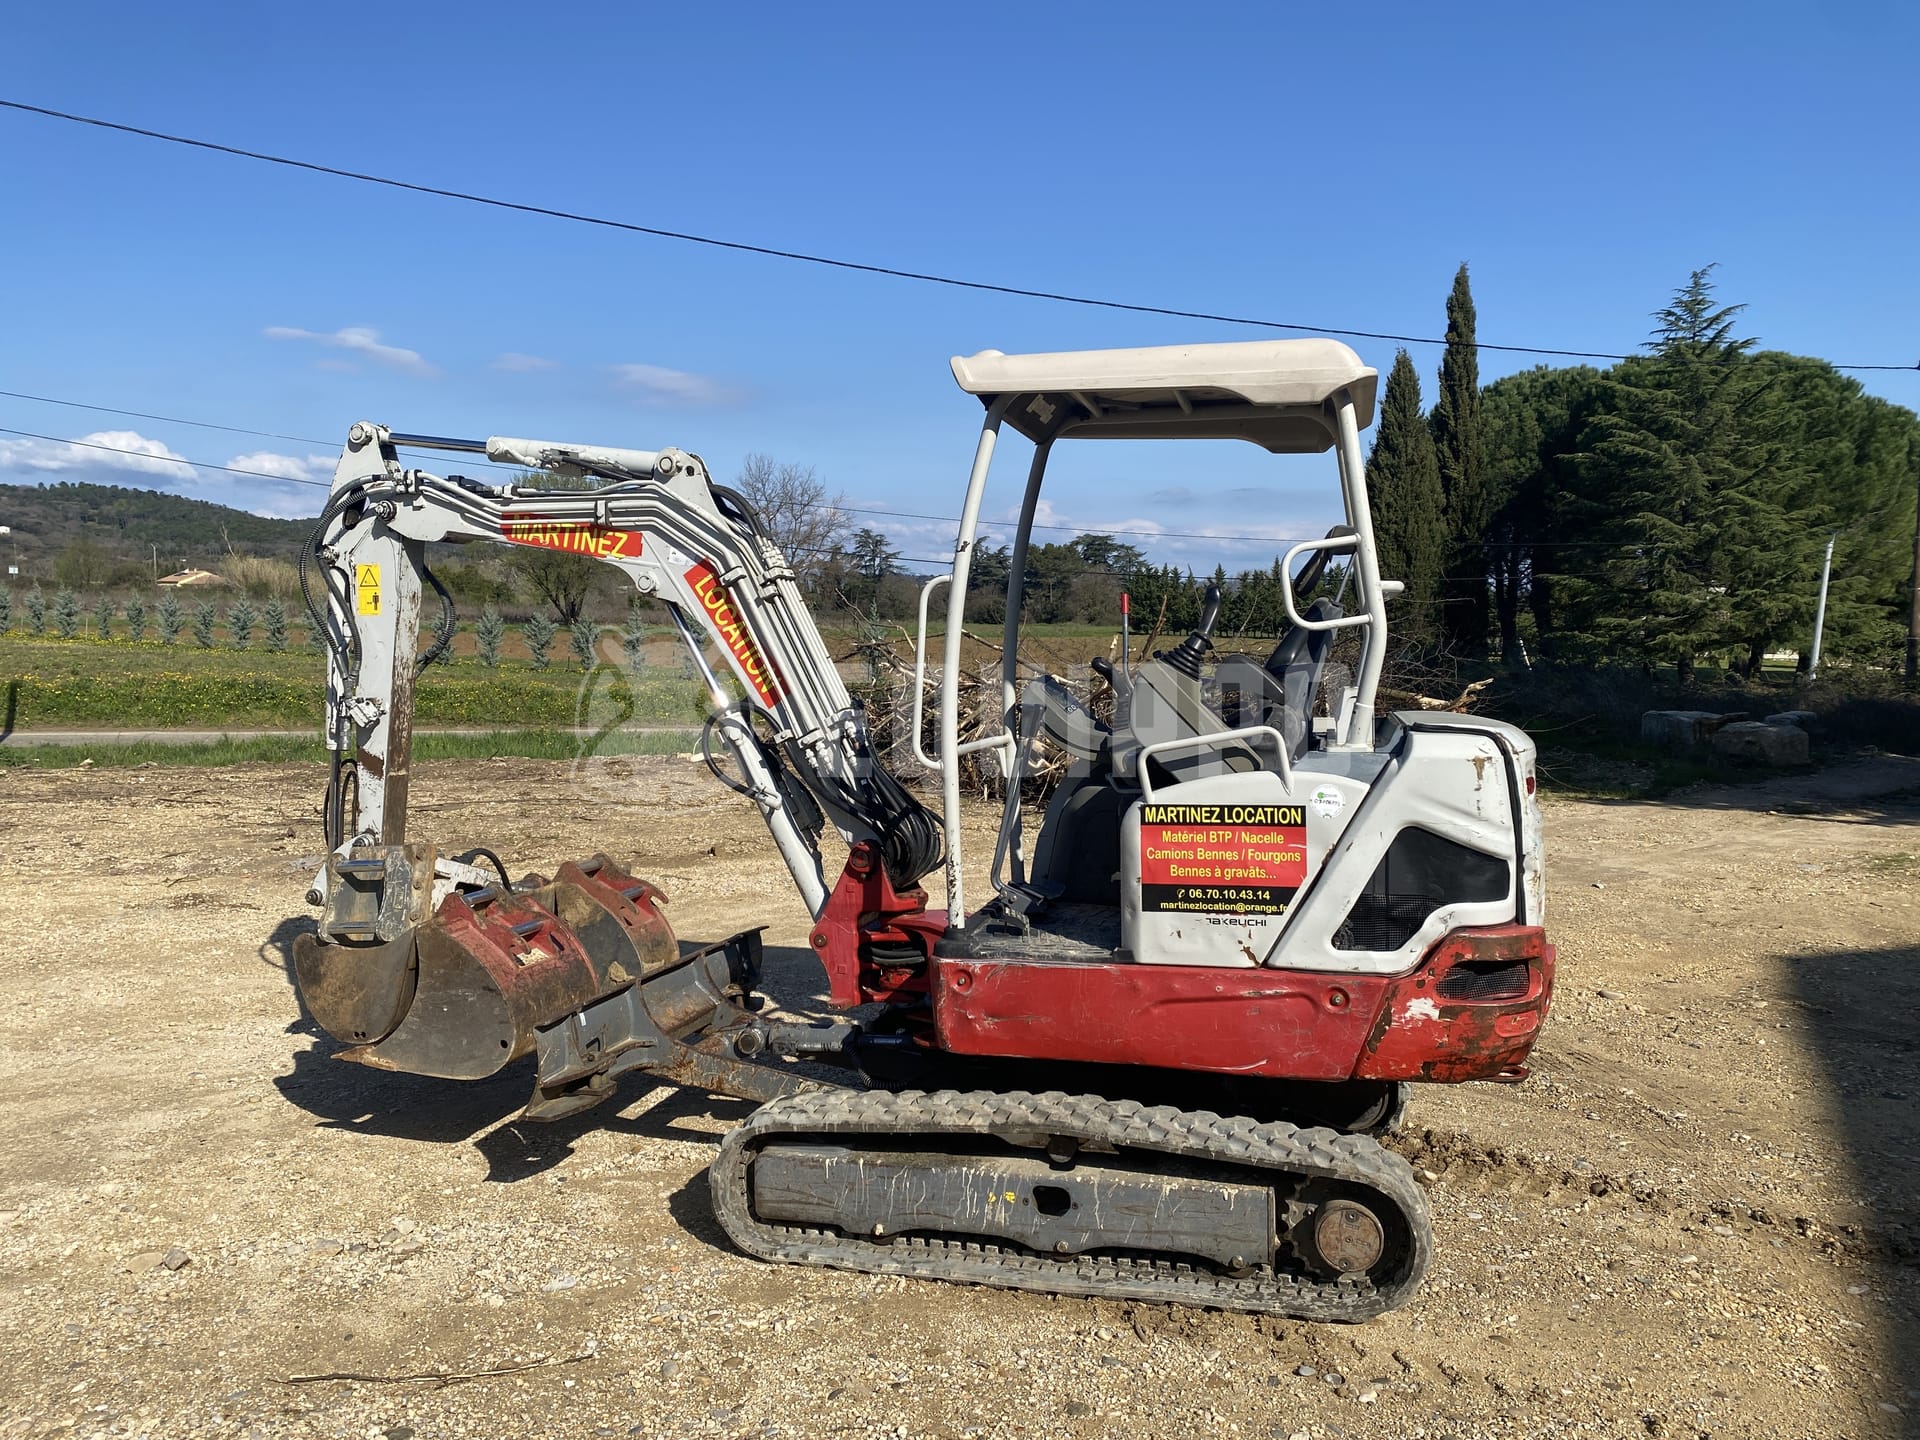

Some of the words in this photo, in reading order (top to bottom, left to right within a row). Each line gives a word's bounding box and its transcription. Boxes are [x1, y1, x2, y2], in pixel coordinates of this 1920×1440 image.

[511, 514, 628, 559] MARTINEZ
[694, 573, 777, 693] LOCATION
[1144, 806, 1221, 823] MARTINEZ
[1224, 807, 1302, 824] LOCATION
[1162, 830, 1207, 843] Matériel
[1209, 831, 1232, 844] BTP
[1234, 831, 1239, 844] /
[1241, 831, 1285, 845] Nacelle
[1146, 847, 1194, 860] Camions
[1197, 848, 1239, 861] Bennes
[1241, 848, 1245, 862] /
[1247, 848, 1301, 864] Fourgons
[1170, 864, 1212, 877] Bennes
[1214, 865, 1221, 877] à
[1224, 865, 1276, 880] gravâts...
[1188, 888, 1271, 900] 06.70.10.43.14
[1160, 902, 1288, 913] martinezlocation@orange.fr
